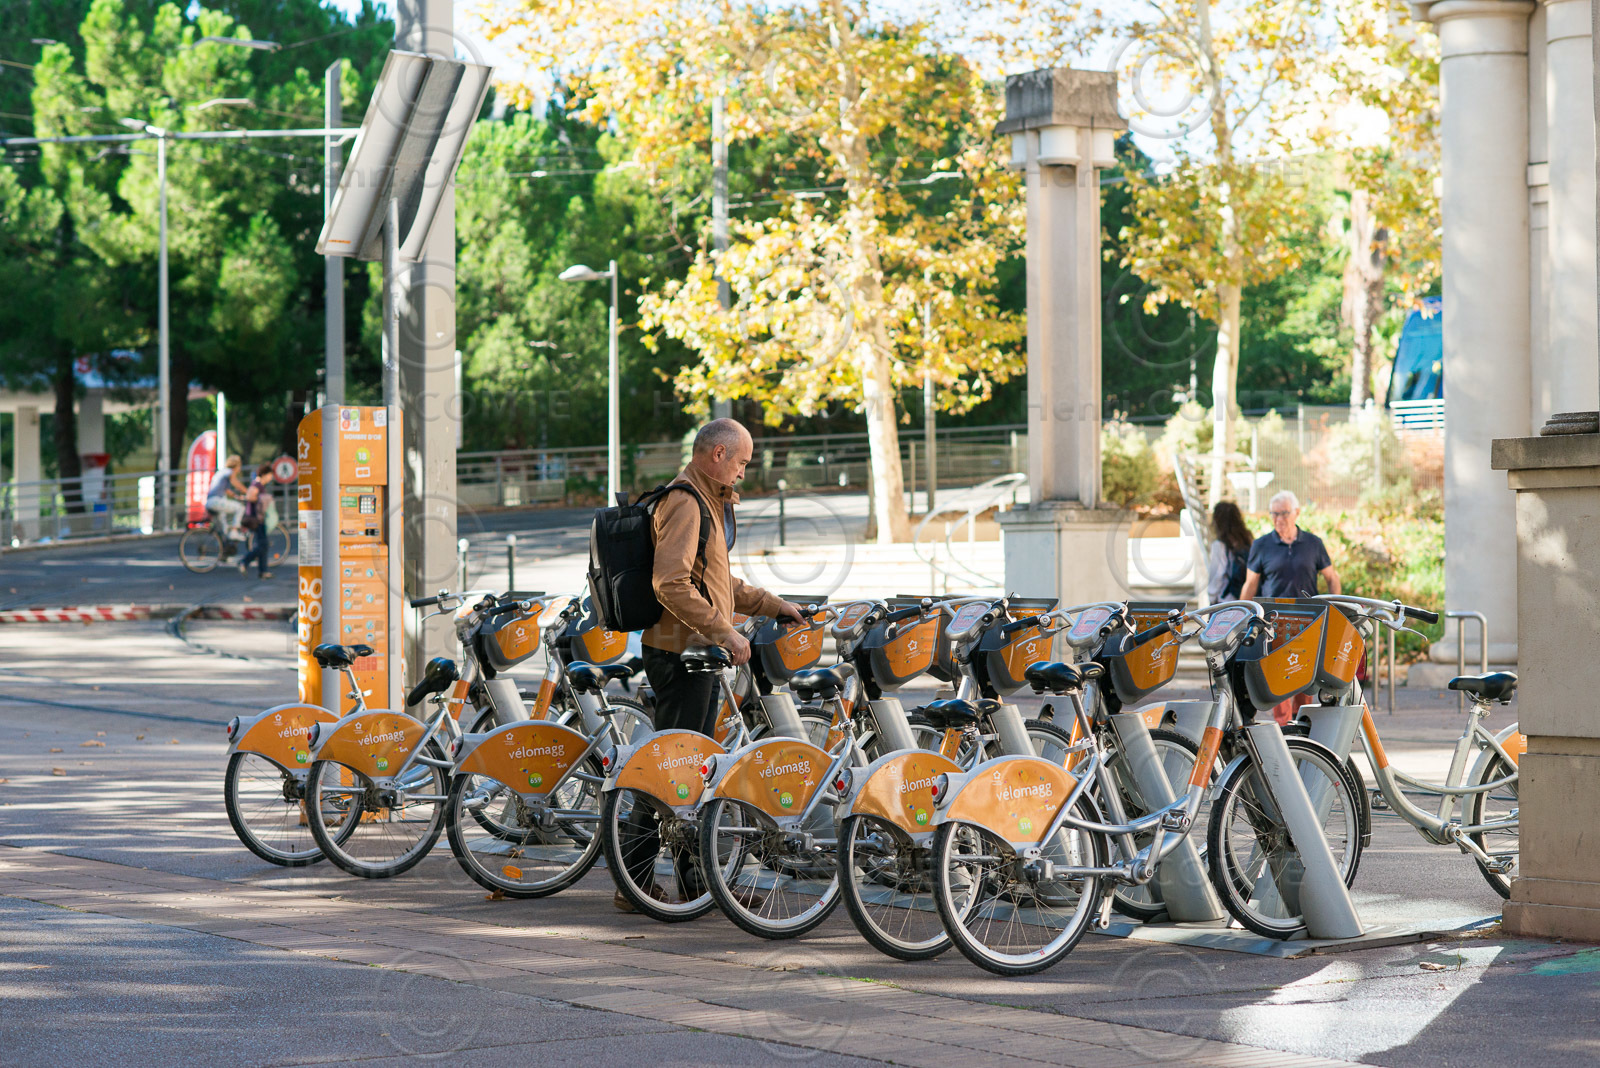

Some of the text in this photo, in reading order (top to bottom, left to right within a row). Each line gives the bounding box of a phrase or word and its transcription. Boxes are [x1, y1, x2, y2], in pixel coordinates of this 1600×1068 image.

[358, 452, 367, 461] 18
[358, 730, 405, 746] vélomagg
[509, 744, 565, 760] vélomagg
[657, 753, 705, 771] vélomagg
[759, 760, 811, 779] vélomagg
[530, 776, 542, 784] 659
[996, 782, 1053, 802] vélomagg
[916, 812, 927, 821] 497
